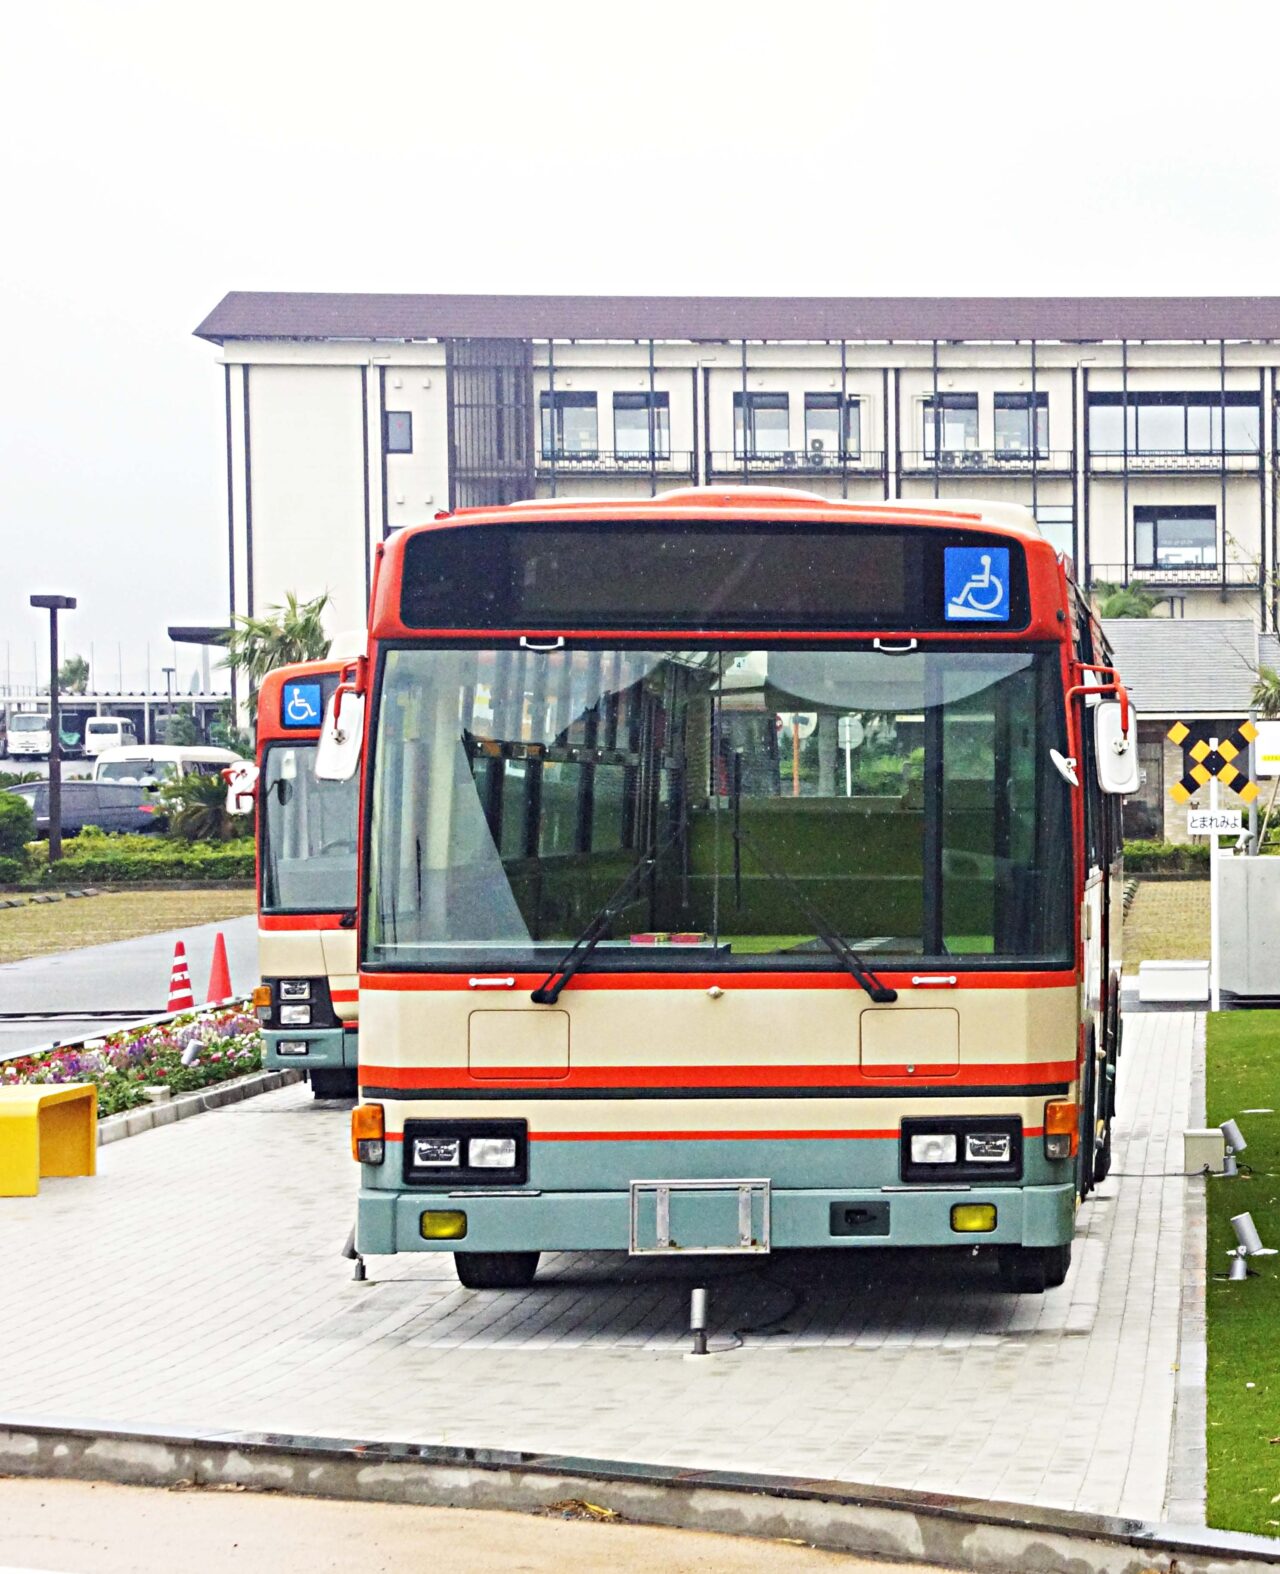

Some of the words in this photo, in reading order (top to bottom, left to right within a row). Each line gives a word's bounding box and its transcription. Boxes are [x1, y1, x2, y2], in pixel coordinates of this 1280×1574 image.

[1190, 815, 1239, 829] とまれみよ
